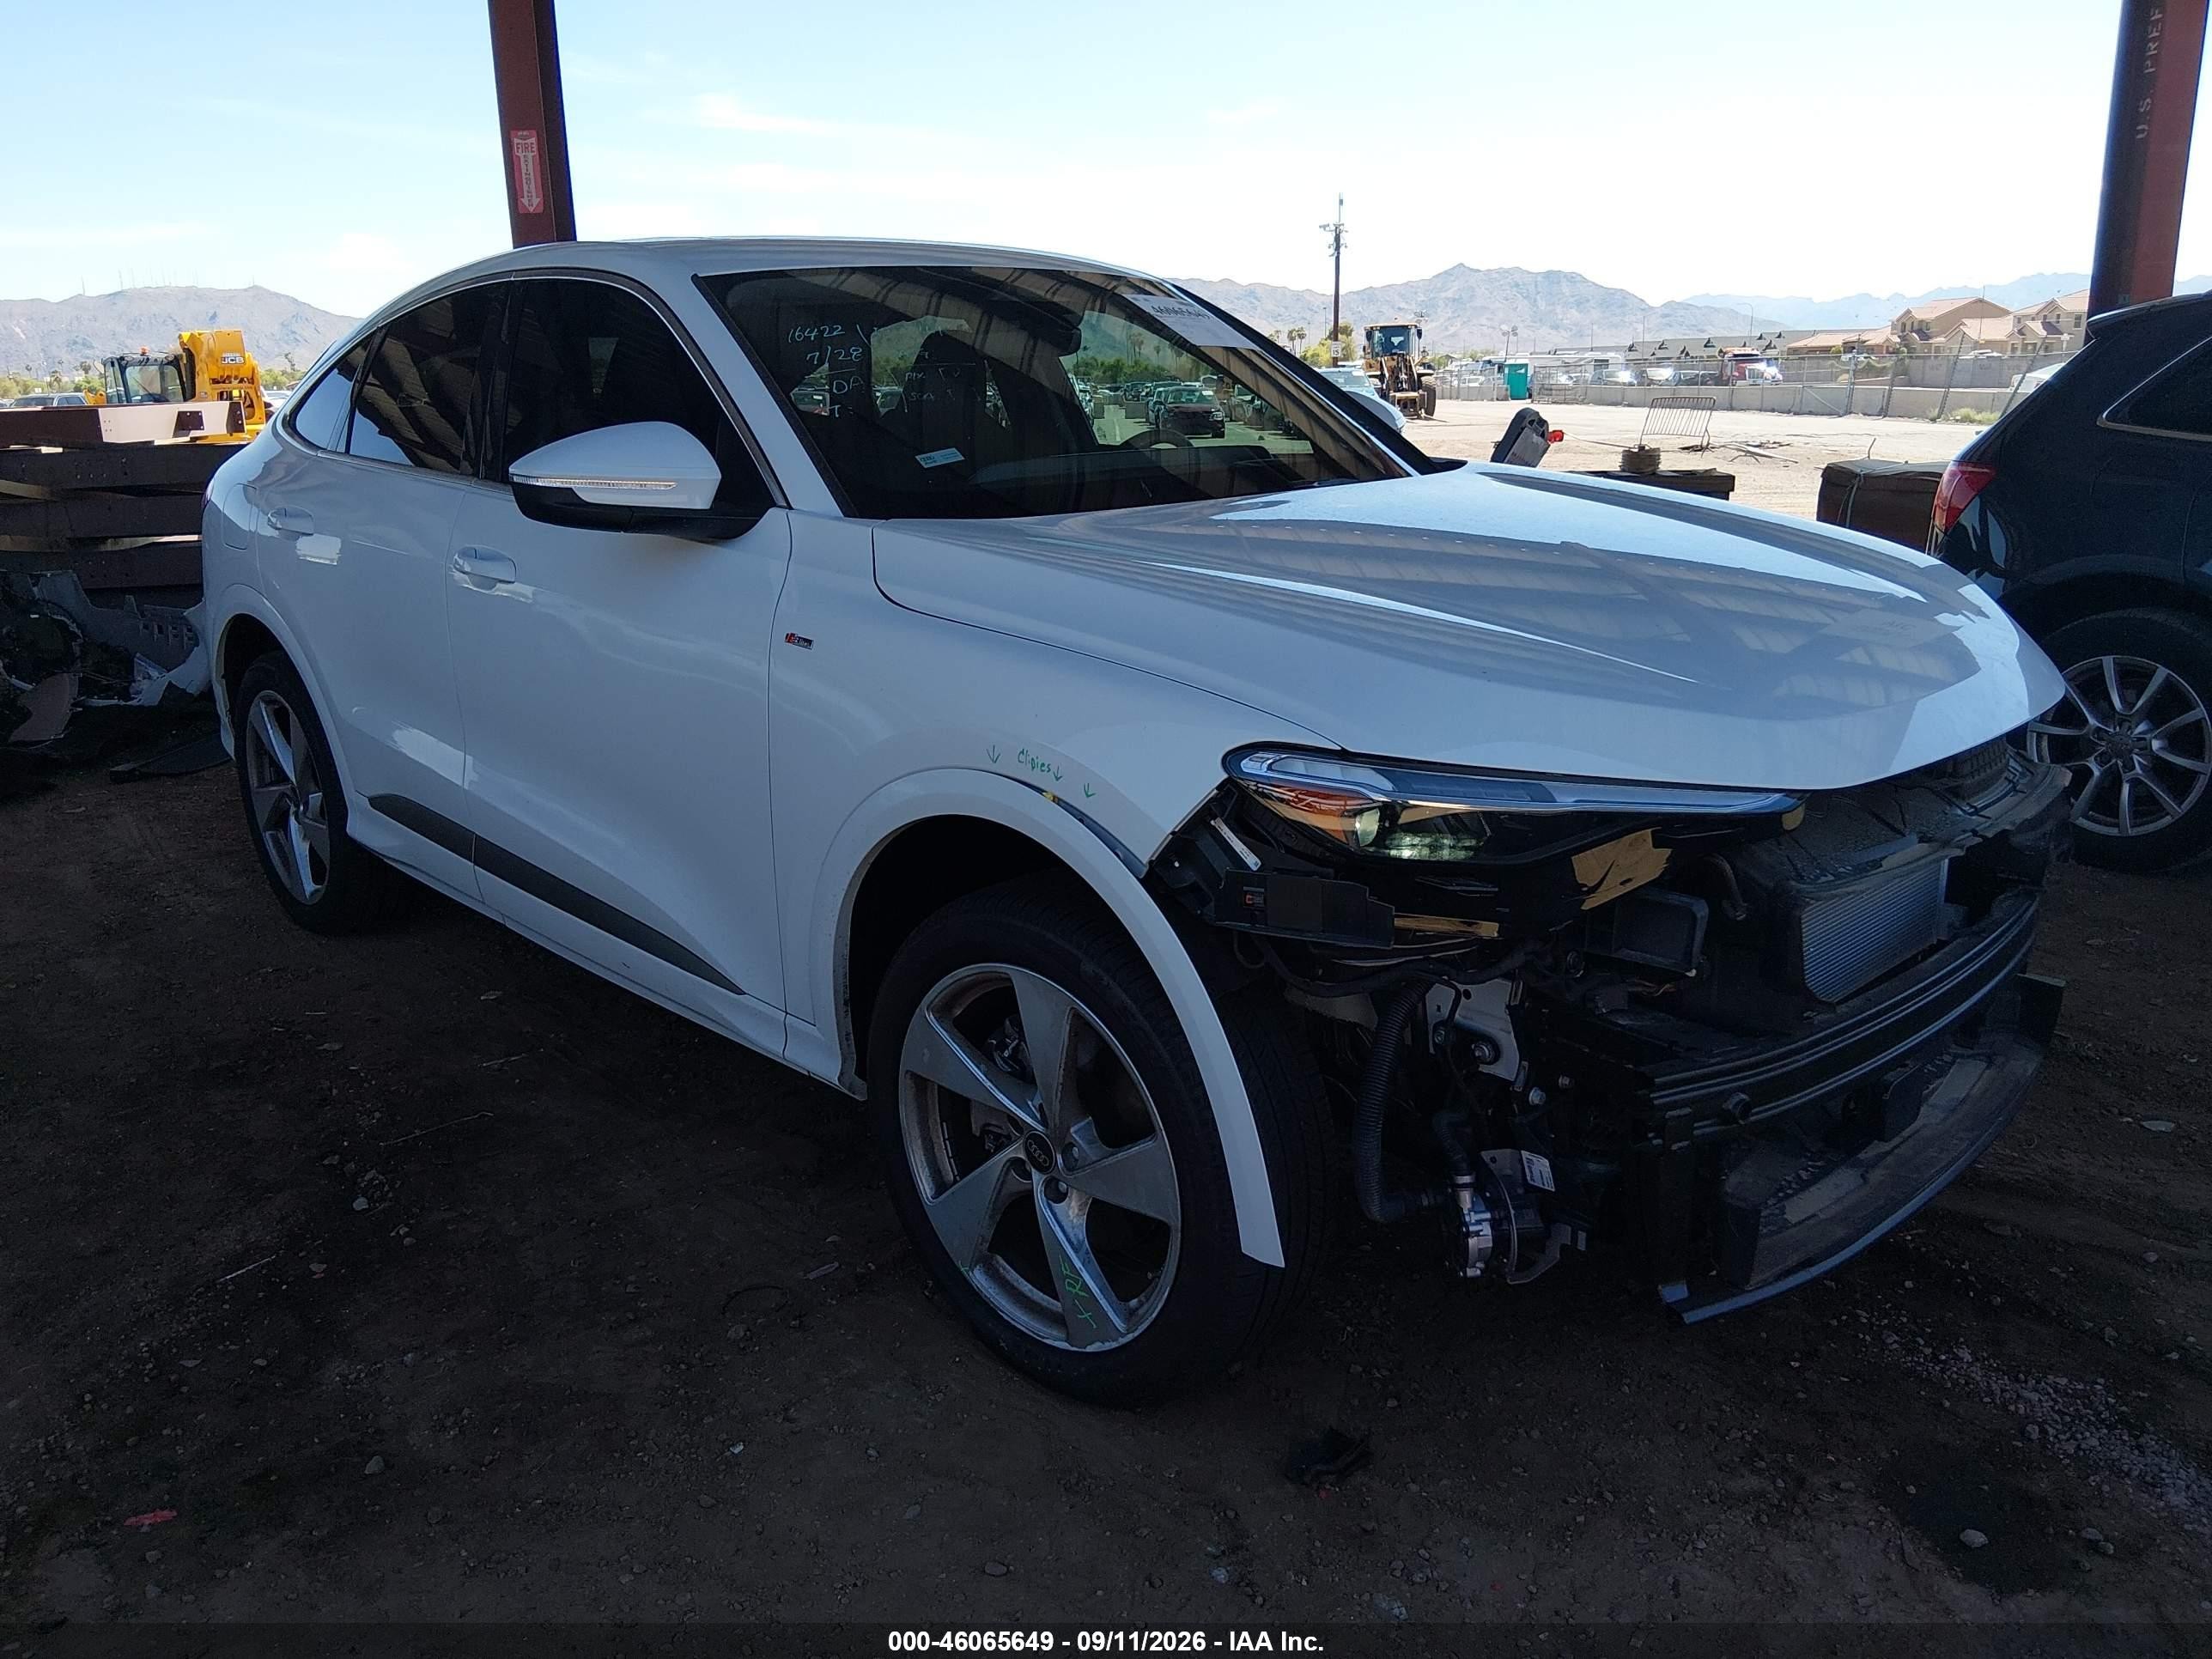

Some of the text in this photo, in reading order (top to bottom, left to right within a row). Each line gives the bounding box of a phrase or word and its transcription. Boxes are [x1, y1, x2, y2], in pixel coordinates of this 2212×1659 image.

[515, 142, 536, 154] FIRE
[788, 325, 845, 343] 16422
[806, 345, 863, 364] 7/28
